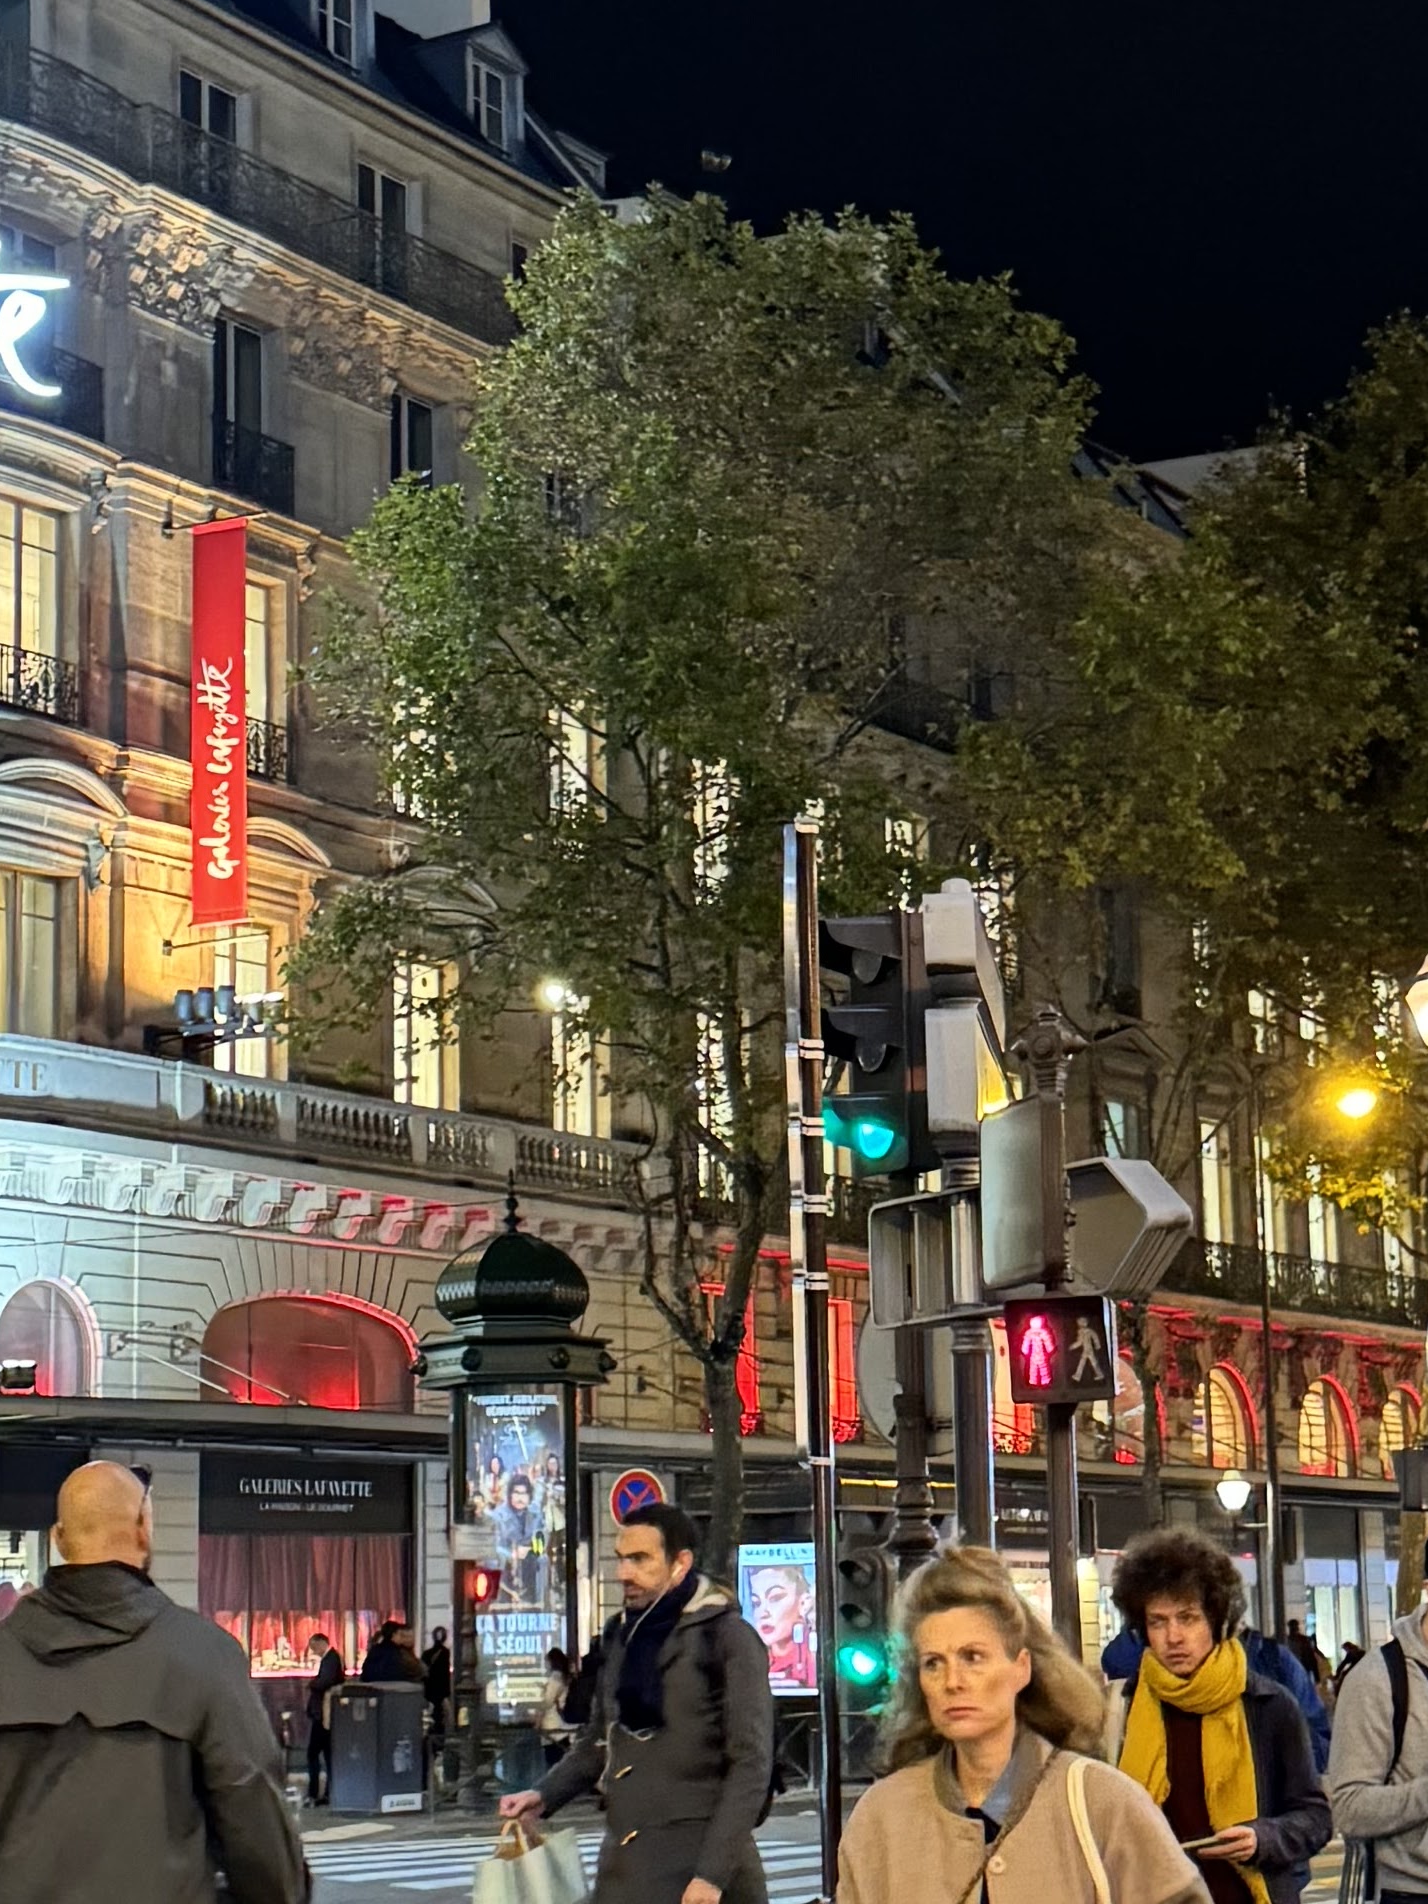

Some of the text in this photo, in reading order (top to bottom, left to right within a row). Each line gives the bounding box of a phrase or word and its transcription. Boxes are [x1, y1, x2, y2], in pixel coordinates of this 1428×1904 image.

[196, 656, 240, 880] Galeries Lafayette
[239, 1478, 373, 1497] GALERIES LAFAYETTE
